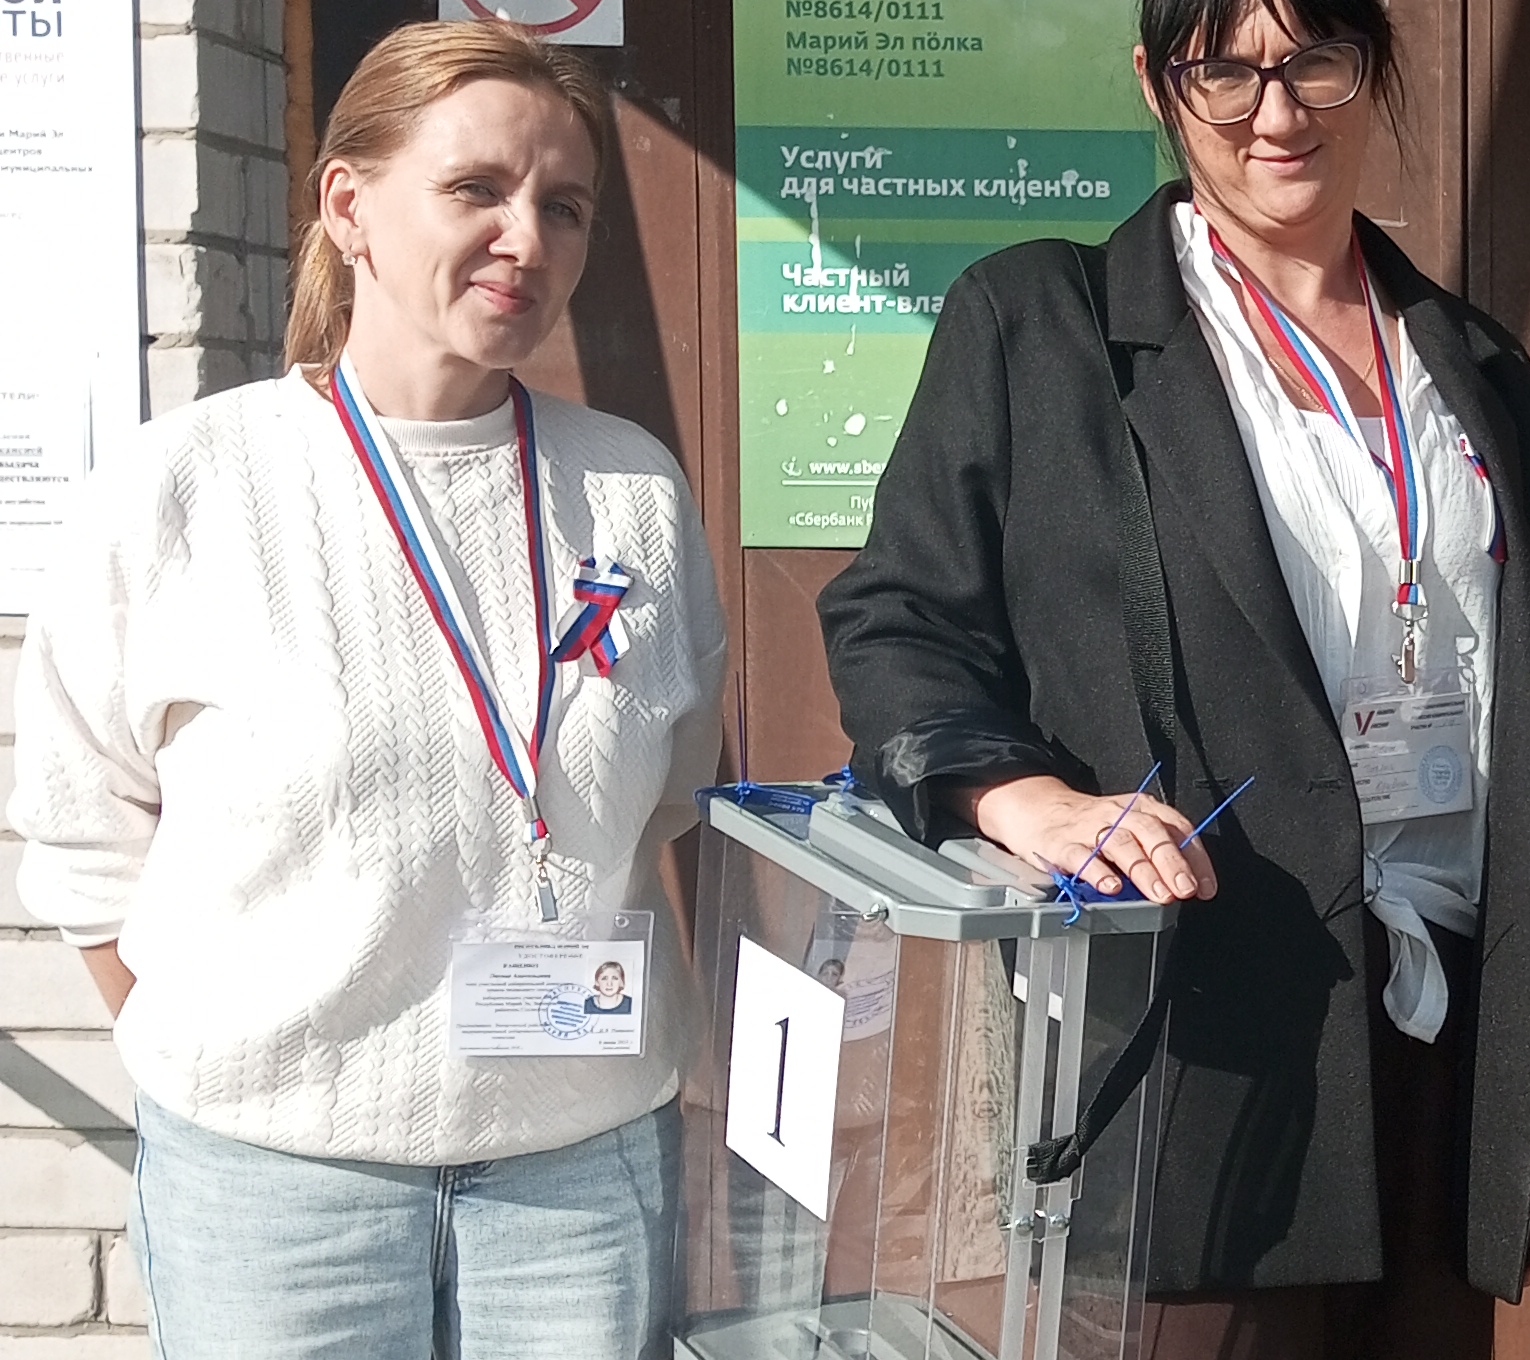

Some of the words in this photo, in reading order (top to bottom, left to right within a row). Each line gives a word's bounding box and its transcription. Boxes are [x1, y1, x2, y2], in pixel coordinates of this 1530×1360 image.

[786, 1, 944, 22] №8614/0111
[786, 31, 868, 54] Марий
[875, 33, 904, 51] Эл
[786, 58, 945, 80] №8614/0111
[781, 146, 883, 174] Услуги
[781, 177, 834, 199] для
[843, 177, 965, 197] частных
[974, 178, 1110, 198] клиентов
[783, 263, 909, 287] Частный
[789, 512, 863, 529] «Сбербанк
[766, 1016, 790, 1147] 1
